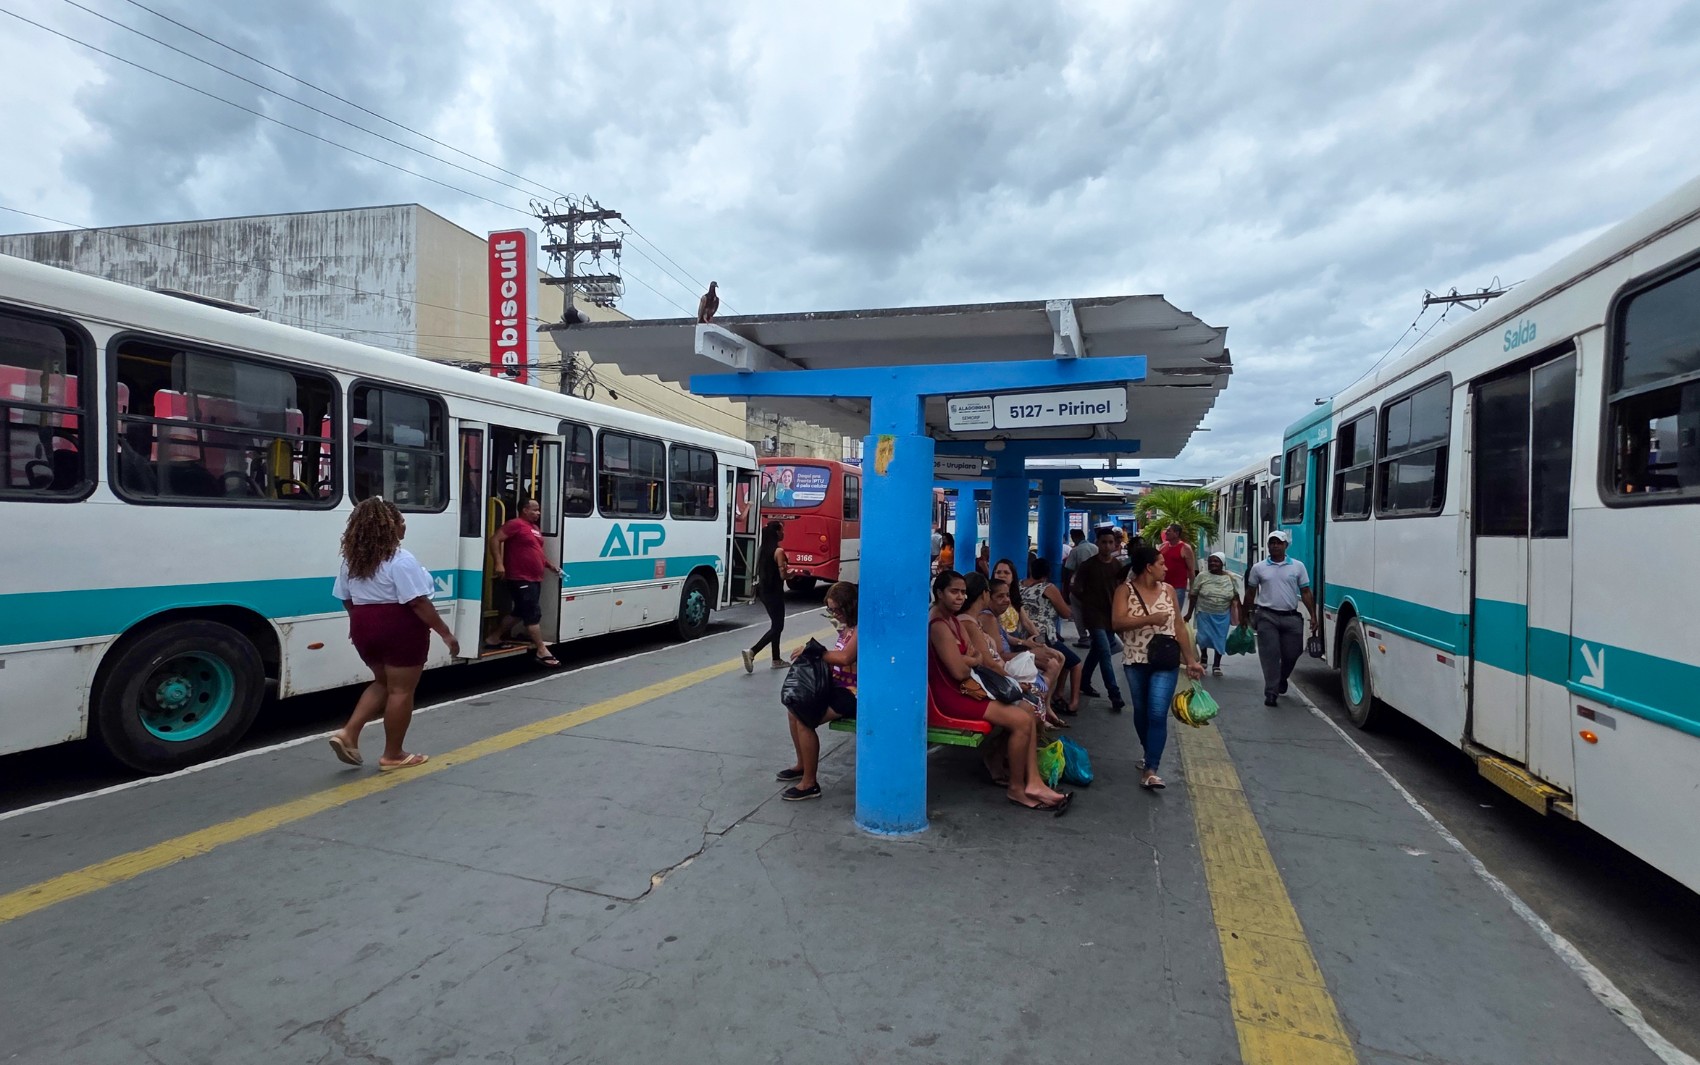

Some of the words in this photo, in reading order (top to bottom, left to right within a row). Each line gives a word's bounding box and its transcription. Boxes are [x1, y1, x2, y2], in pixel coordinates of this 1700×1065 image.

[494, 239, 518, 347] biscuit
[1503, 318, 1537, 352] Saída
[1010, 405, 1043, 419] 5127
[1058, 400, 1111, 416] Pirinel
[599, 523, 666, 557] ATP
[796, 554, 813, 562] 3166
